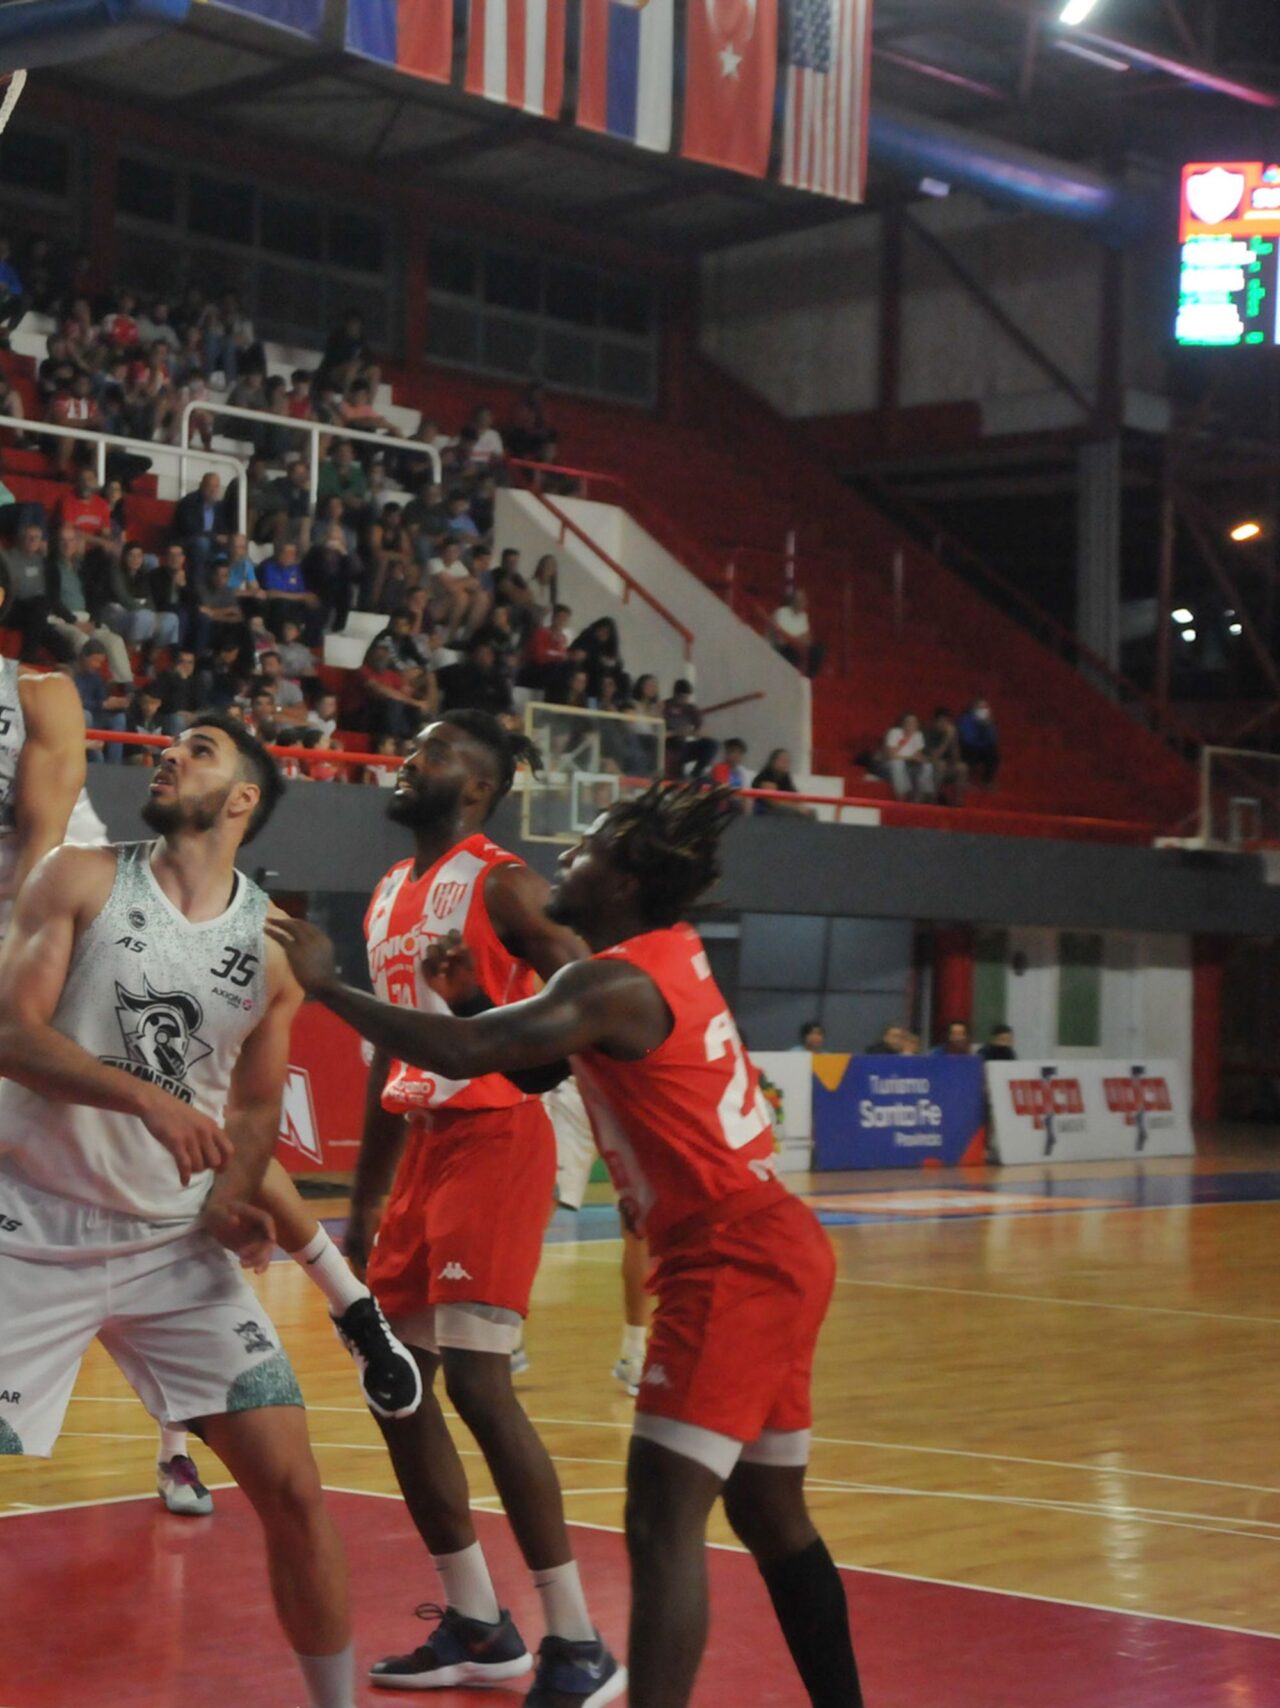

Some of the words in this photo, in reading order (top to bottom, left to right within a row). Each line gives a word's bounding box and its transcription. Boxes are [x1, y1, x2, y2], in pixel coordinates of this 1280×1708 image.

[115, 936, 148, 953] AS
[210, 946, 260, 987] 35
[861, 1099, 916, 1128] Santa
[917, 1099, 942, 1126] Fe
